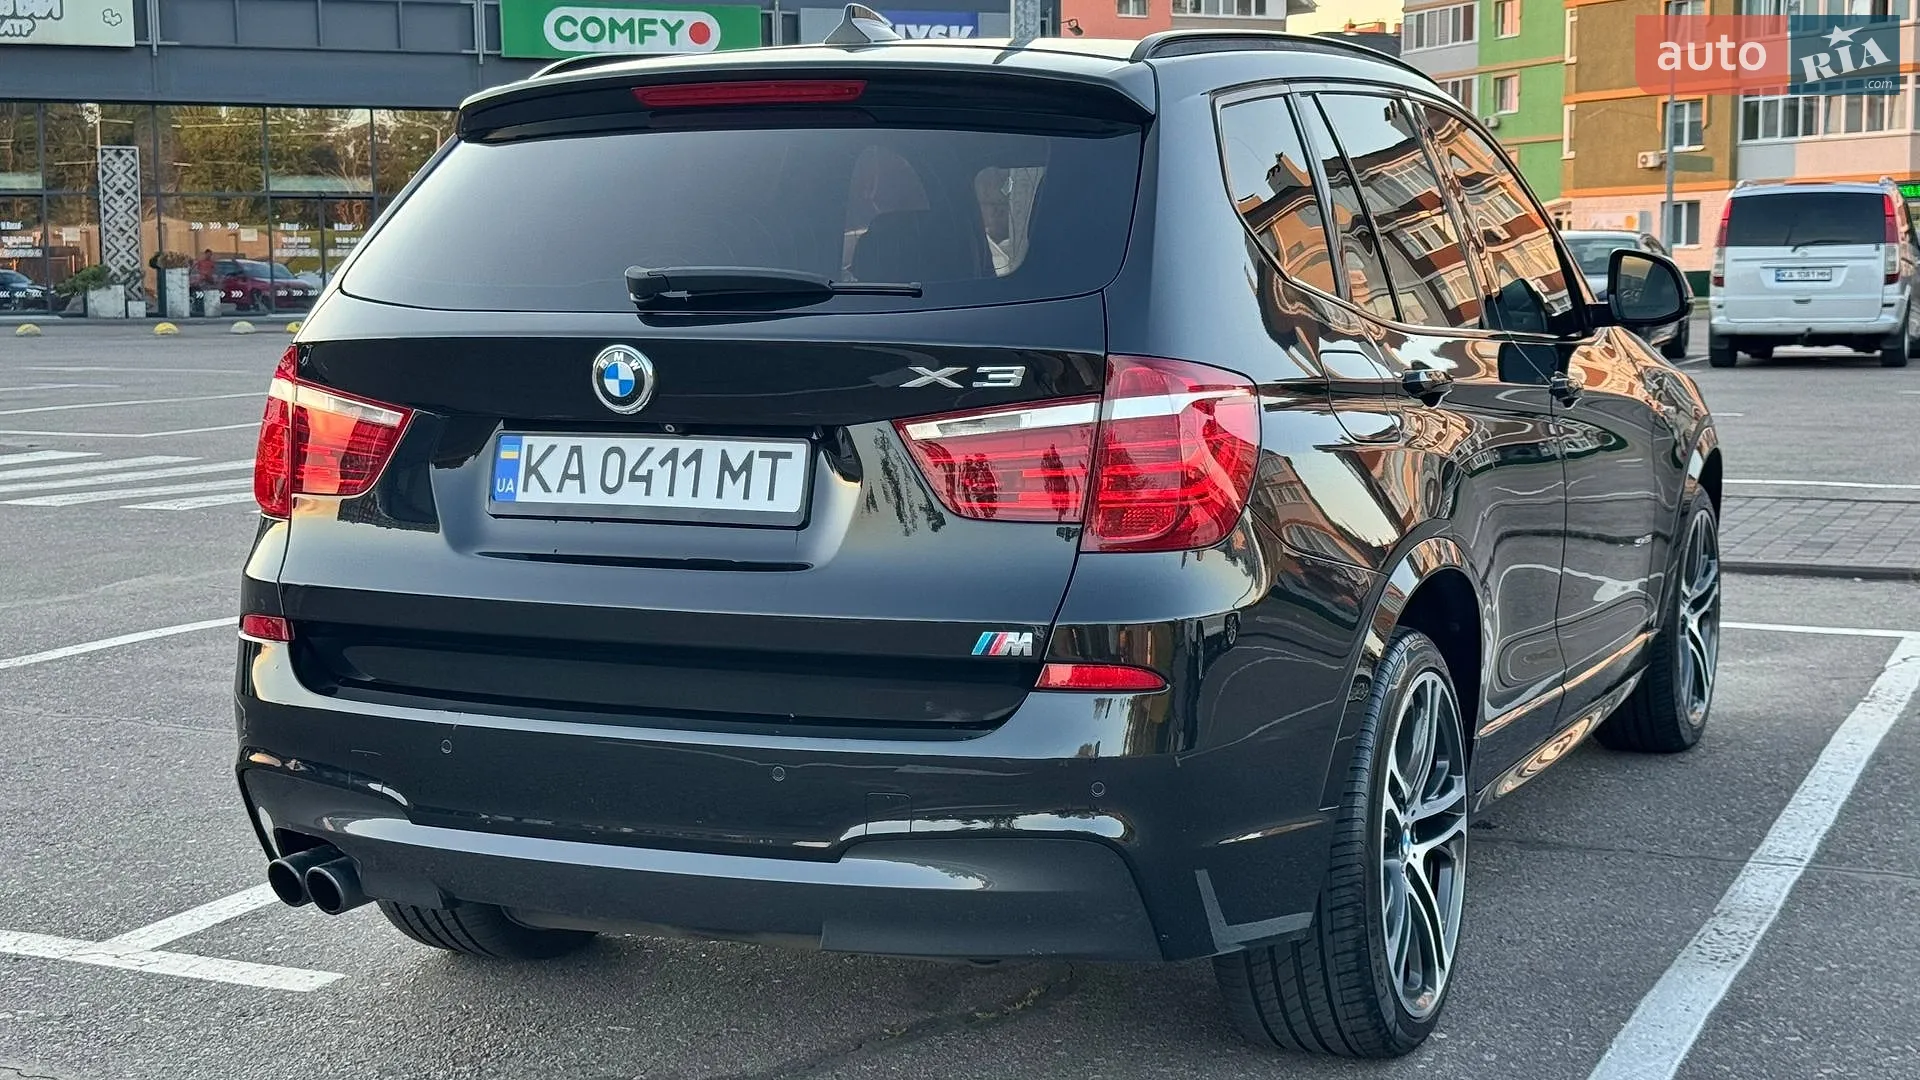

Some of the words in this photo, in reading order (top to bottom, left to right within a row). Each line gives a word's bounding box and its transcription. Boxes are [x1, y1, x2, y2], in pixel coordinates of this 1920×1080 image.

[554, 15, 685, 46] COMFY
[599, 351, 641, 371] BMW
[899, 366, 1025, 388] X3
[522, 444, 586, 494] KA
[599, 446, 703, 498] 0411
[716, 448, 793, 501] MT
[497, 477, 514, 493] UA
